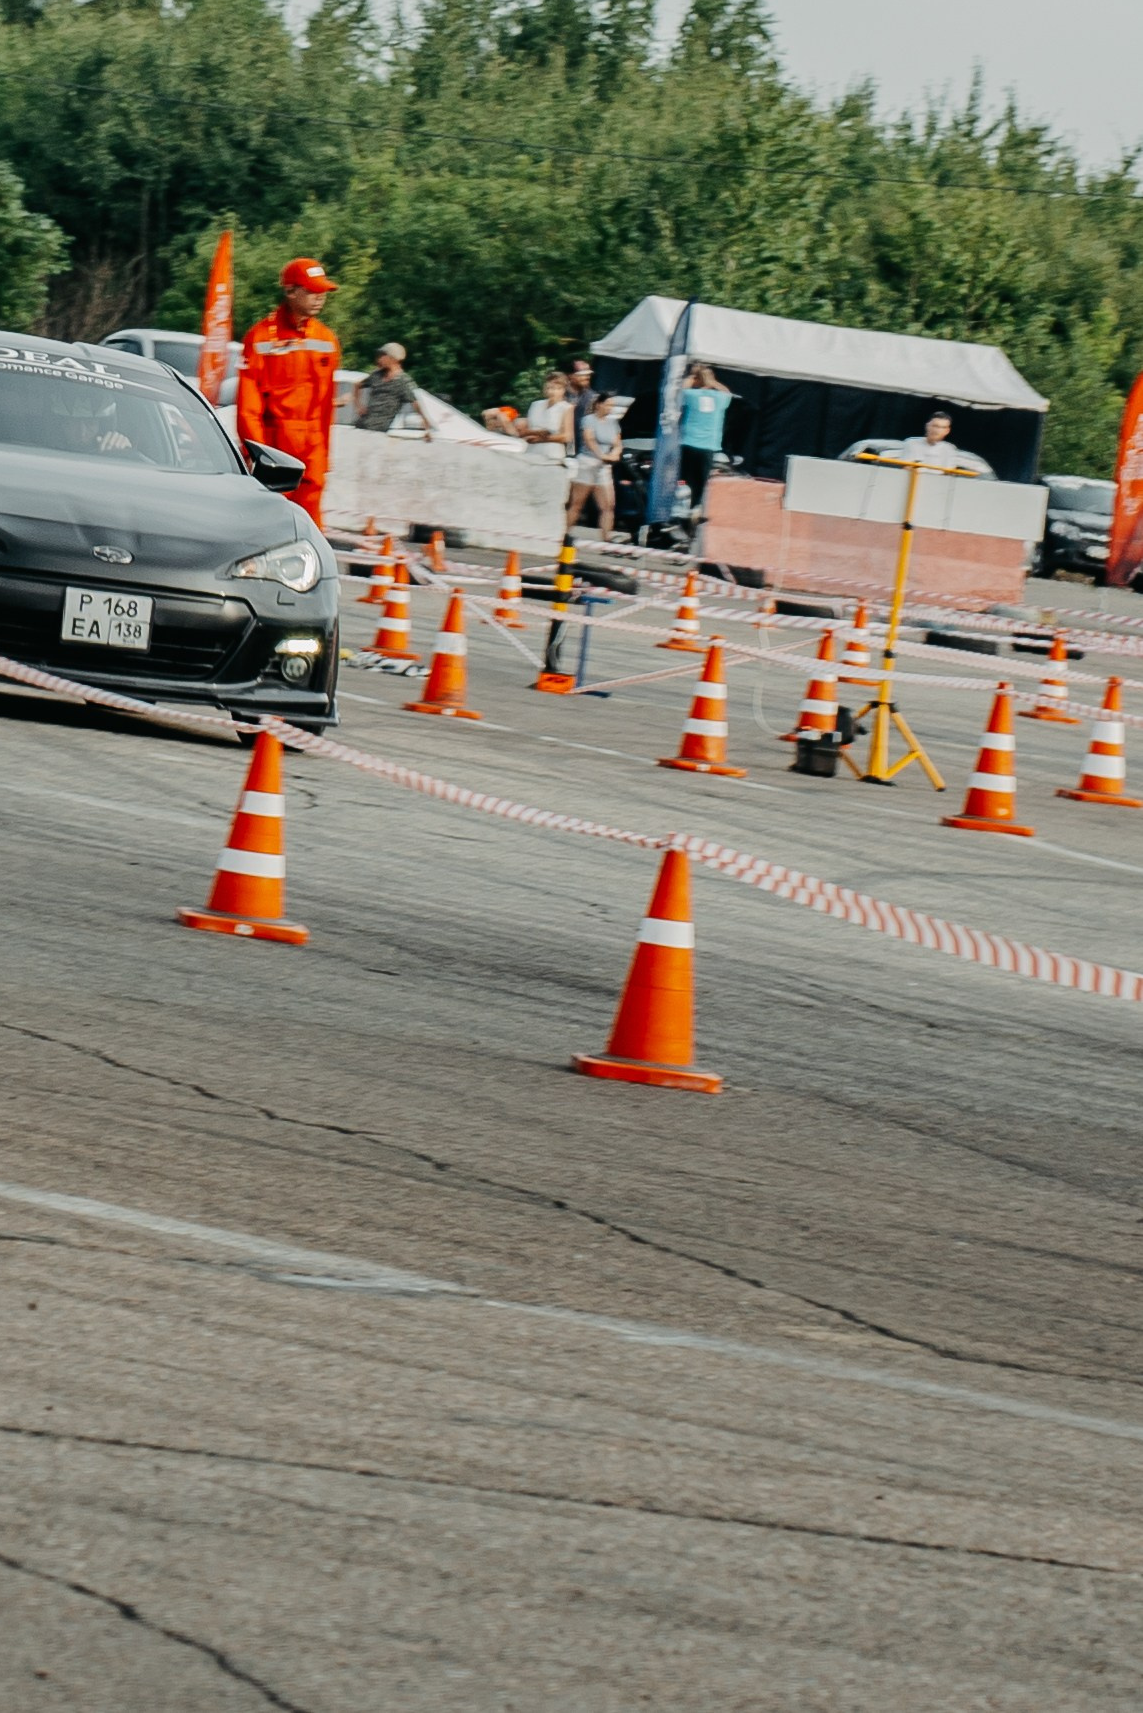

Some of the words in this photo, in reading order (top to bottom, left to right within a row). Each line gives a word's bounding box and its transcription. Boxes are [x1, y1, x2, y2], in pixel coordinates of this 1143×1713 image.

[65, 371, 124, 389] Garage
[103, 597, 137, 617] 168
[115, 622, 142, 639] 138
